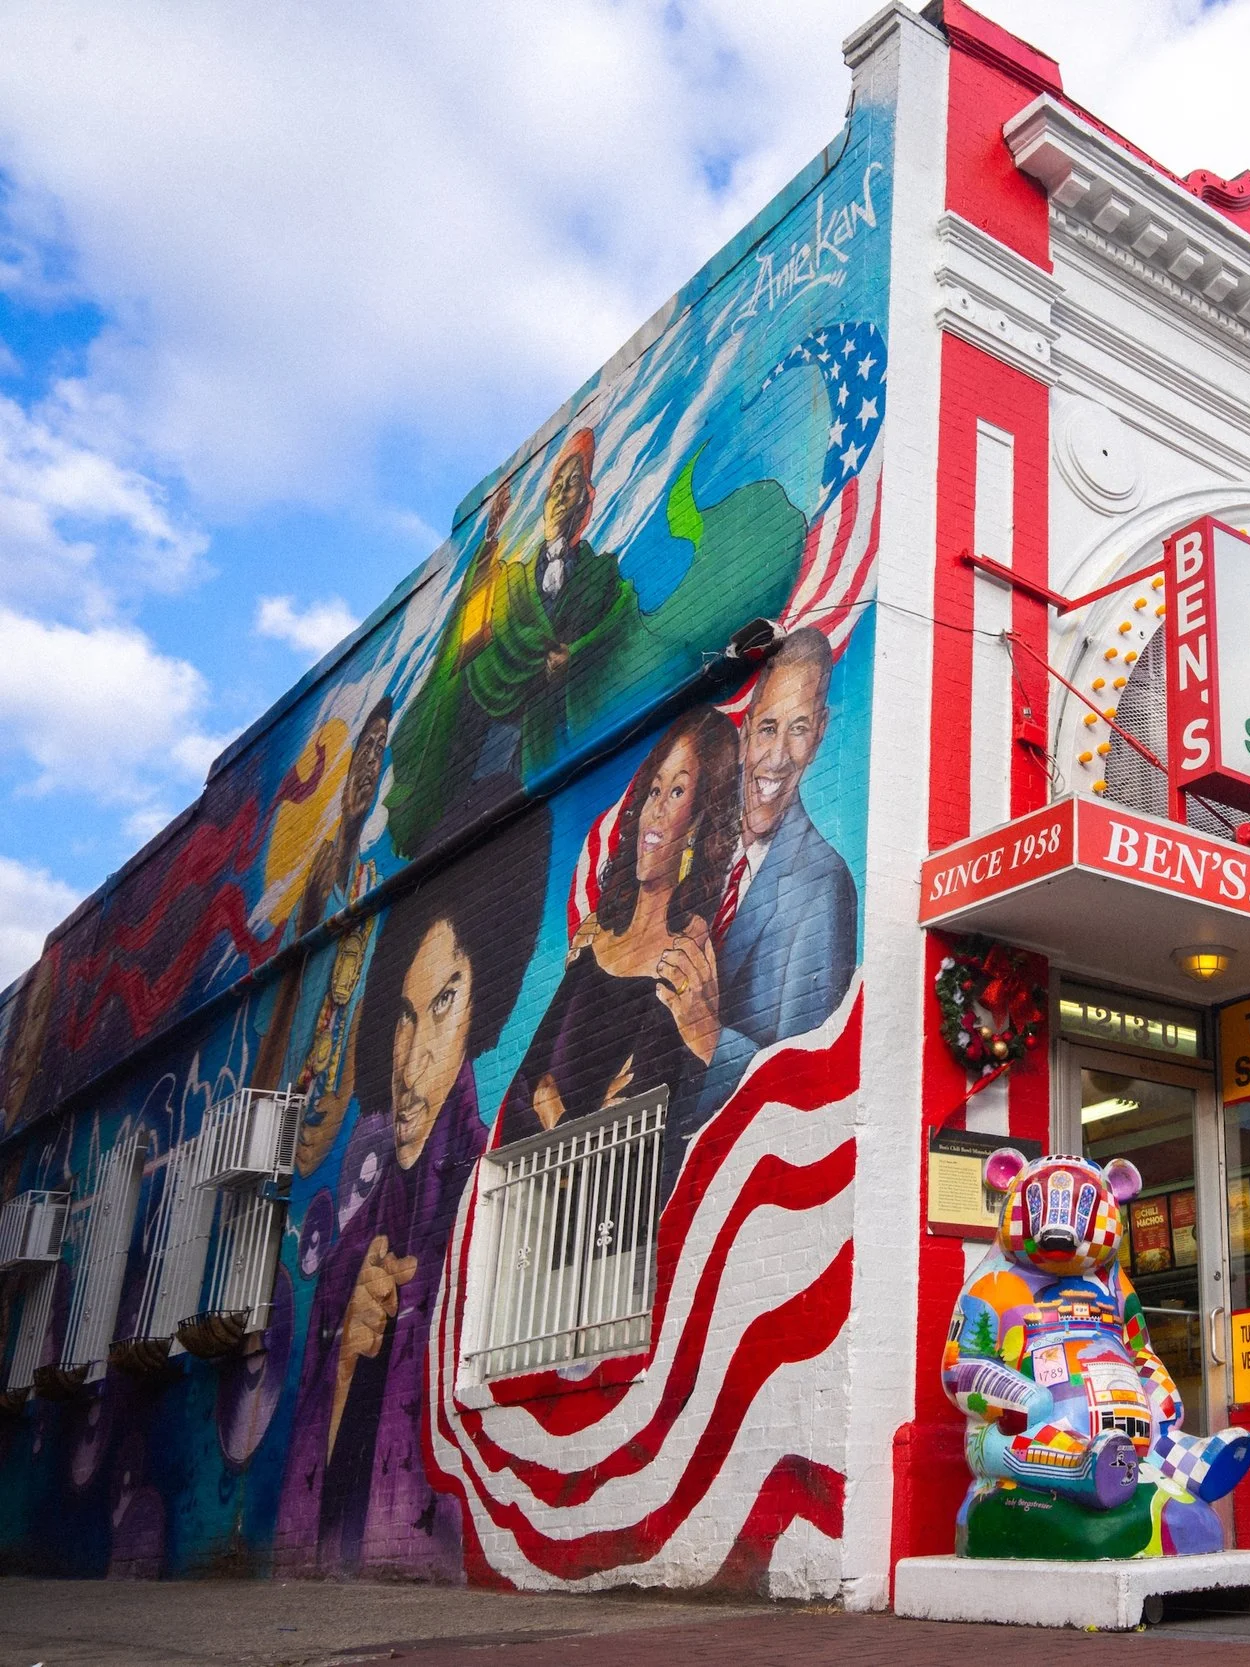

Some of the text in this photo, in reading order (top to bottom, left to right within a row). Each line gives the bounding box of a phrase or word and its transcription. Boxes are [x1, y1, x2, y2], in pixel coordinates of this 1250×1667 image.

[1174, 530, 1211, 772] BEN'S
[929, 823, 1063, 901] SINCE 1958
[1077, 1002, 1150, 1045] 1213
[1135, 1215, 1165, 1230] NACHOS
[1039, 1366, 1064, 1383] 1789
